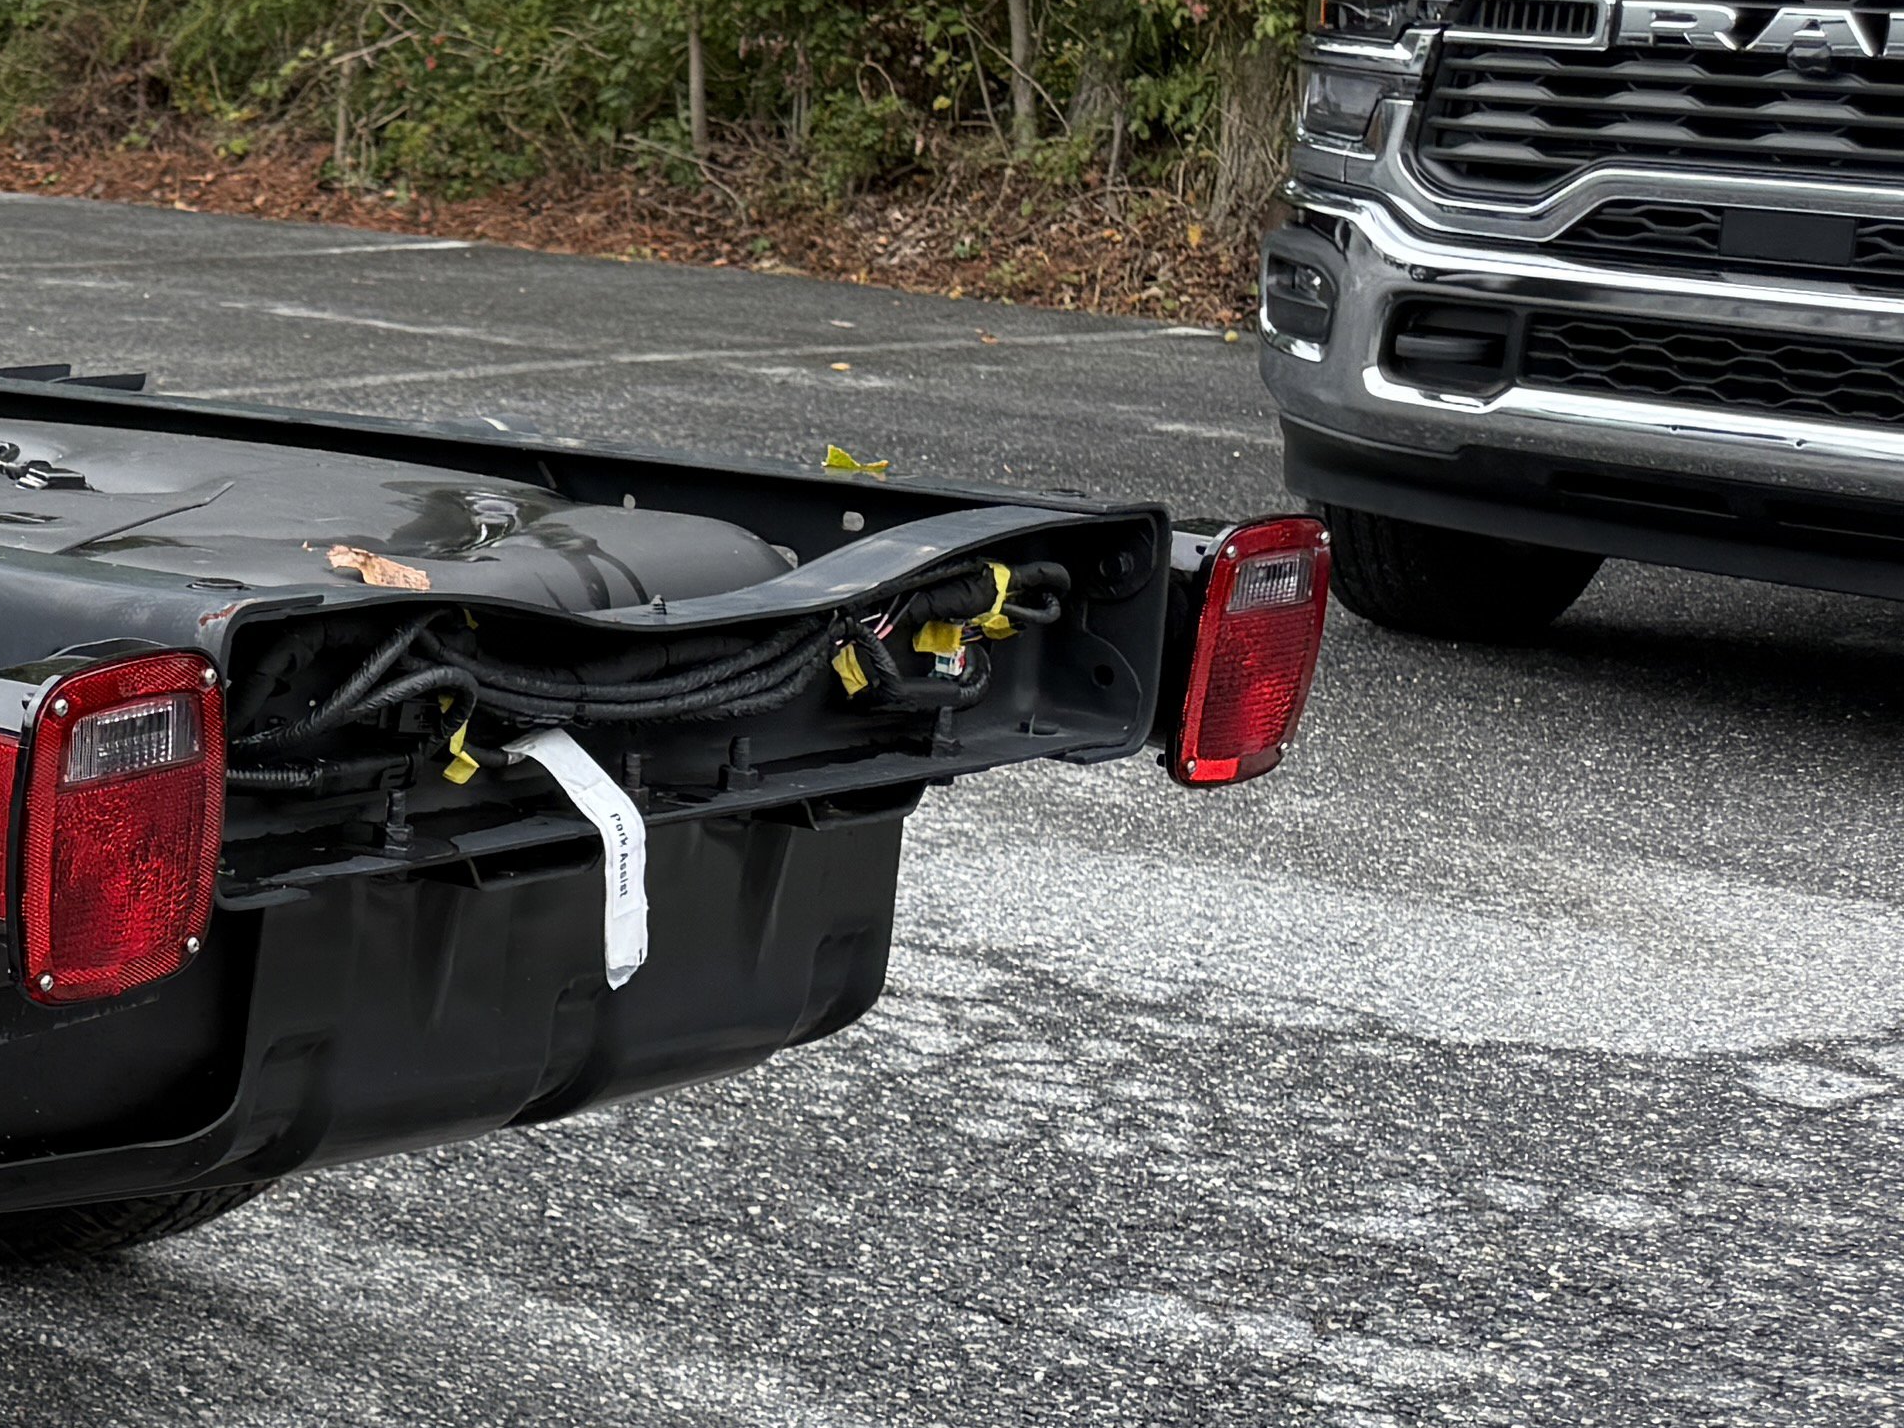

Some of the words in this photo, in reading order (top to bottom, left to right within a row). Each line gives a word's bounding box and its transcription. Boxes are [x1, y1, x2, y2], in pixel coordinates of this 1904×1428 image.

[1616, 0, 1904, 59] RA
[610, 813, 629, 847] Park
[619, 852, 629, 898] Assist
